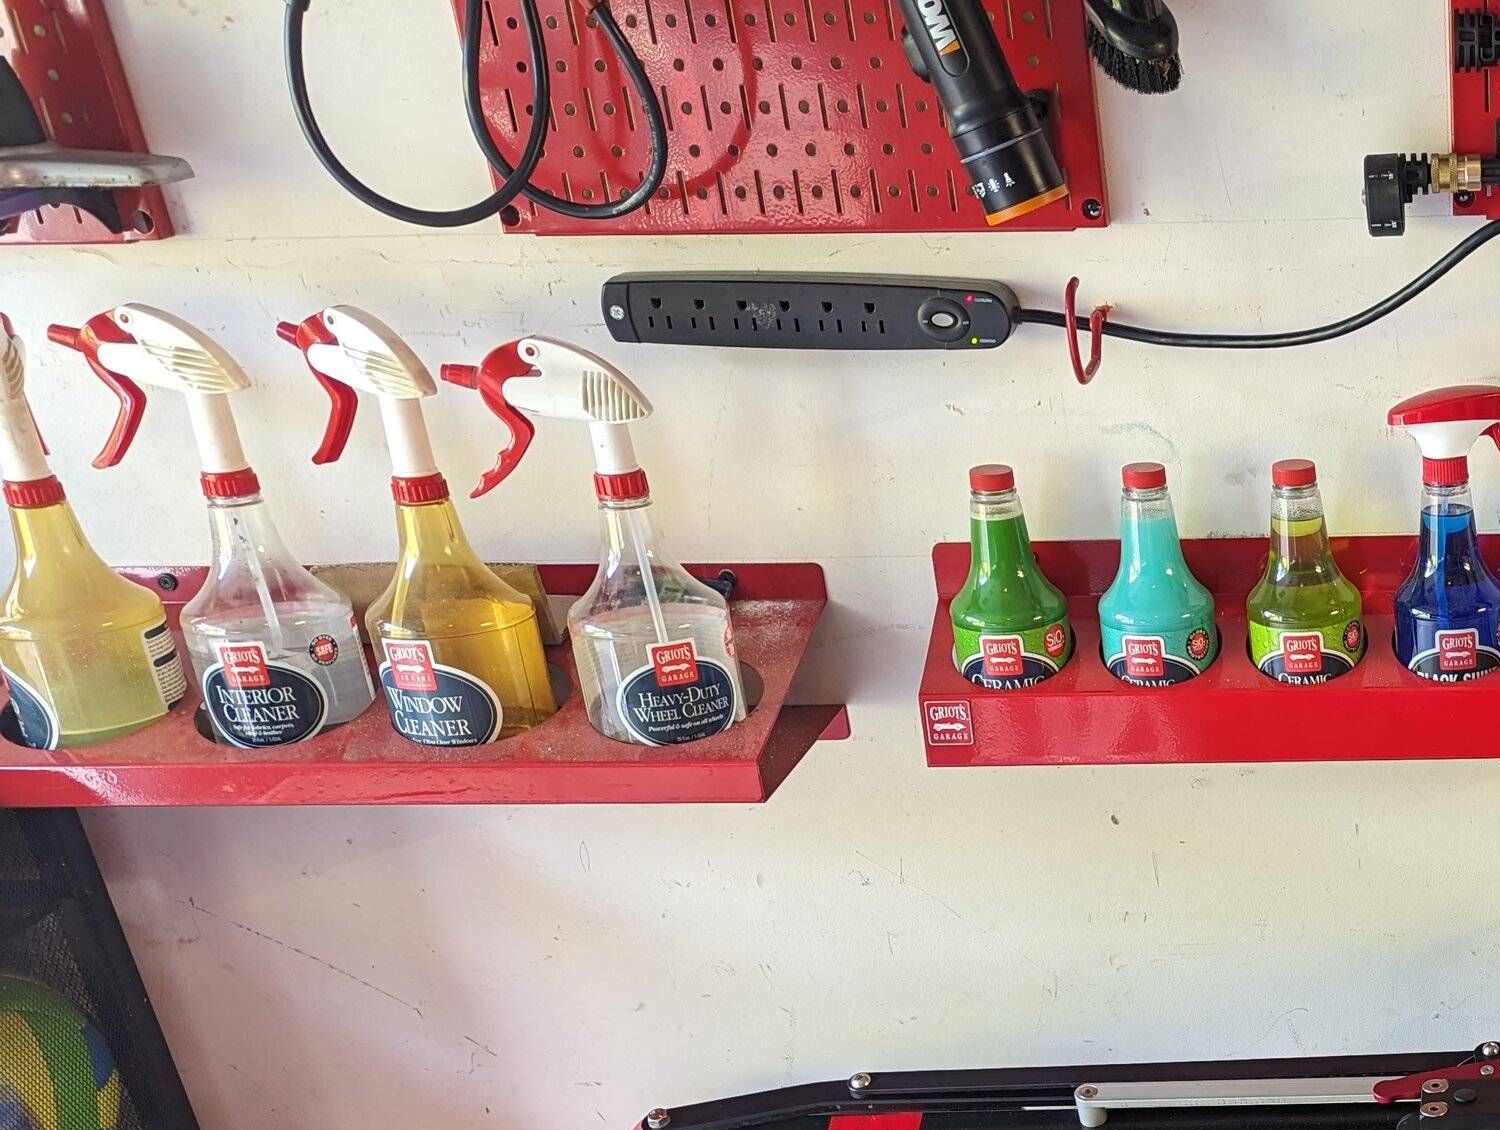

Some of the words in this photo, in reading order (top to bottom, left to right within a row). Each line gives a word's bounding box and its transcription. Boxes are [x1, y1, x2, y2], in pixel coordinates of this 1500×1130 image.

[918, 0, 961, 56] WO
[986, 641, 1017, 655] GRIOT'S
[1128, 642, 1158, 656] GRIOT'S
[1287, 638, 1317, 652] GRIOT'S
[1442, 634, 1473, 650] GRIOT'S
[224, 648, 260, 664] GRIOT'S
[389, 646, 425, 662] GRIOT'S
[656, 645, 691, 664] GRIOT'S
[1444, 659, 1473, 667] GARAGE
[661, 671, 695, 682] GARAGE
[216, 685, 296, 705] INTERIOR
[386, 686, 463, 714] WINDOW
[638, 684, 720, 708] HEAVY-DUTY
[223, 704, 300, 723] CLEANER
[633, 707, 681, 723] WHEEL
[682, 696, 730, 718] CLEANER
[930, 704, 969, 720] GRIOT'S
[395, 710, 472, 737] CLEANER
